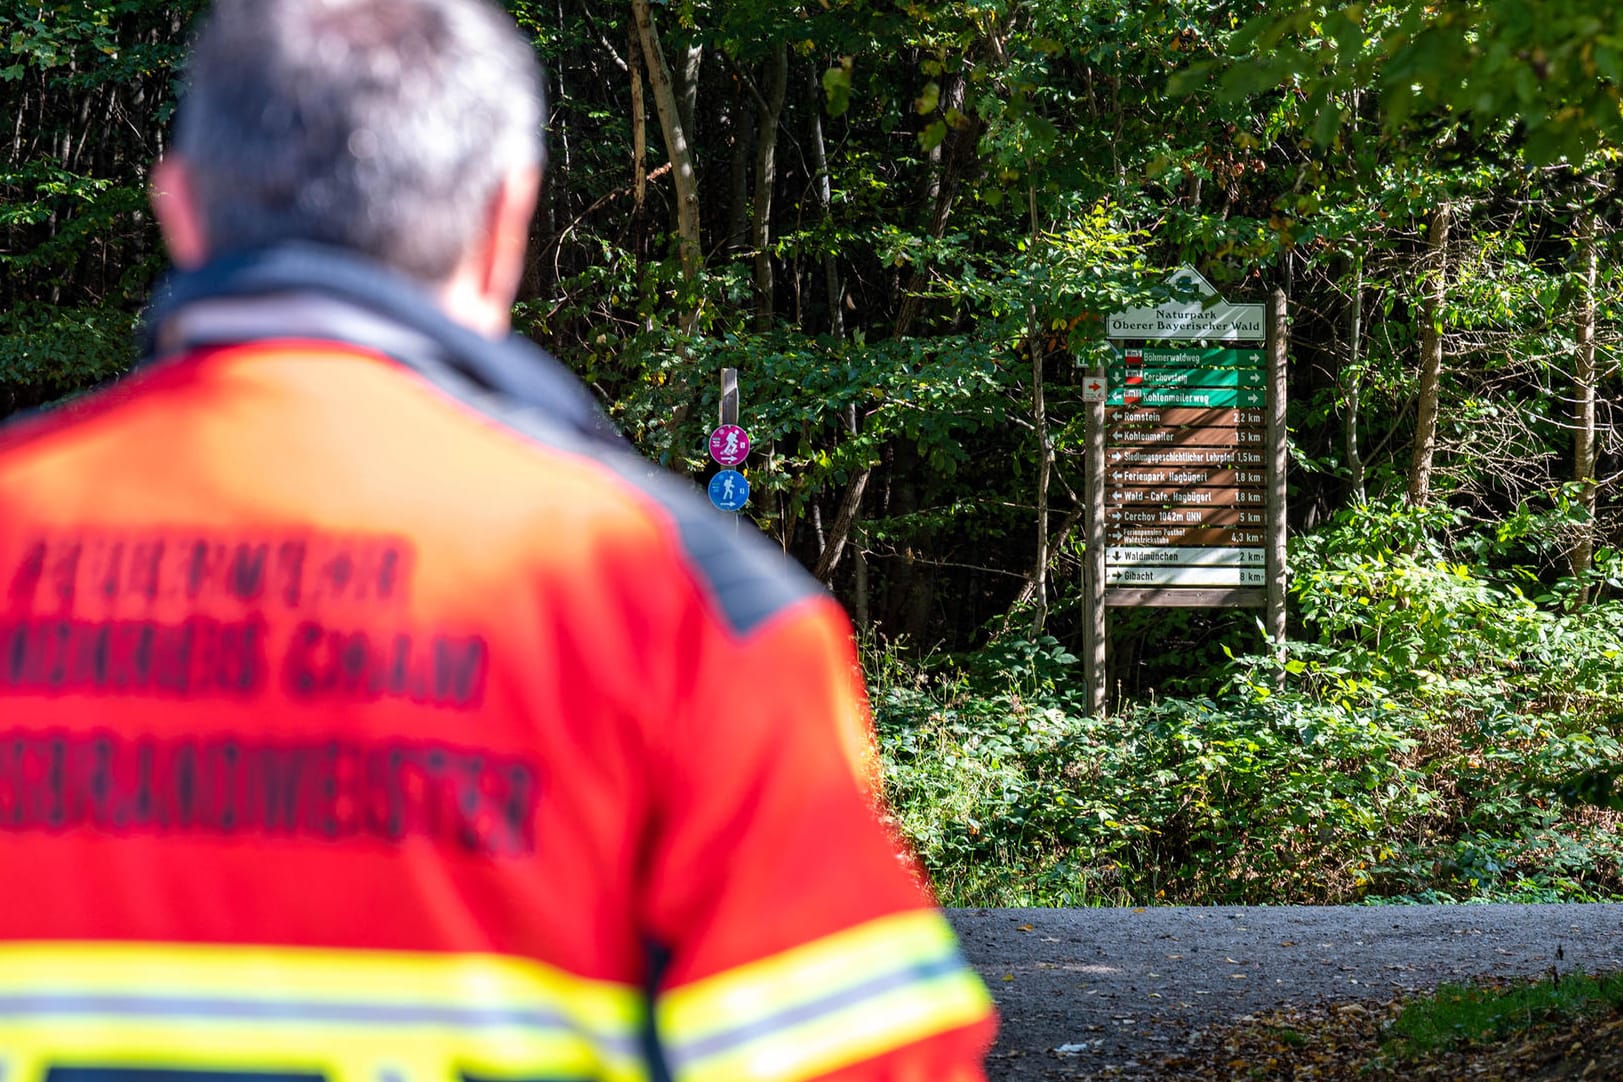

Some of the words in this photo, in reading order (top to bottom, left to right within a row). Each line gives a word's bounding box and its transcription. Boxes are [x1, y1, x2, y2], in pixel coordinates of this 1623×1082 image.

[1156, 310, 1217, 320] Naturpark
[1112, 320, 1154, 330] Oberer
[1157, 320, 1228, 333] Bayerischer
[1231, 321, 1260, 331] Wald
[1143, 352, 1200, 364] Böhmerwaldweg
[1143, 391, 1209, 405] Kohlenmeilerweg
[1124, 412, 1161, 422] Romstein
[1248, 412, 1261, 422] km
[1124, 431, 1174, 441] Kohlenmeiler
[1248, 432, 1261, 442] km
[1124, 450, 1203, 464] Siedlungsgeschichtlicher
[1205, 451, 1235, 464] Lehrpfad
[1124, 471, 1166, 482] Ferienpark
[1248, 472, 1261, 482] km
[1124, 491, 1143, 501] Wald
[1248, 492, 1261, 502] km
[1124, 511, 1156, 521] Cerchov
[1159, 511, 1184, 521] 1042m
[1239, 512, 1245, 522] 5
[1248, 512, 1261, 522] km
[1246, 532, 1259, 542] km
[1124, 551, 1178, 561] Waldmünchen
[1240, 551, 1245, 561] 2
[1248, 551, 1261, 561] km
[1124, 571, 1153, 581] Gibacht
[1240, 571, 1245, 581] 8
[1248, 571, 1261, 581] km
